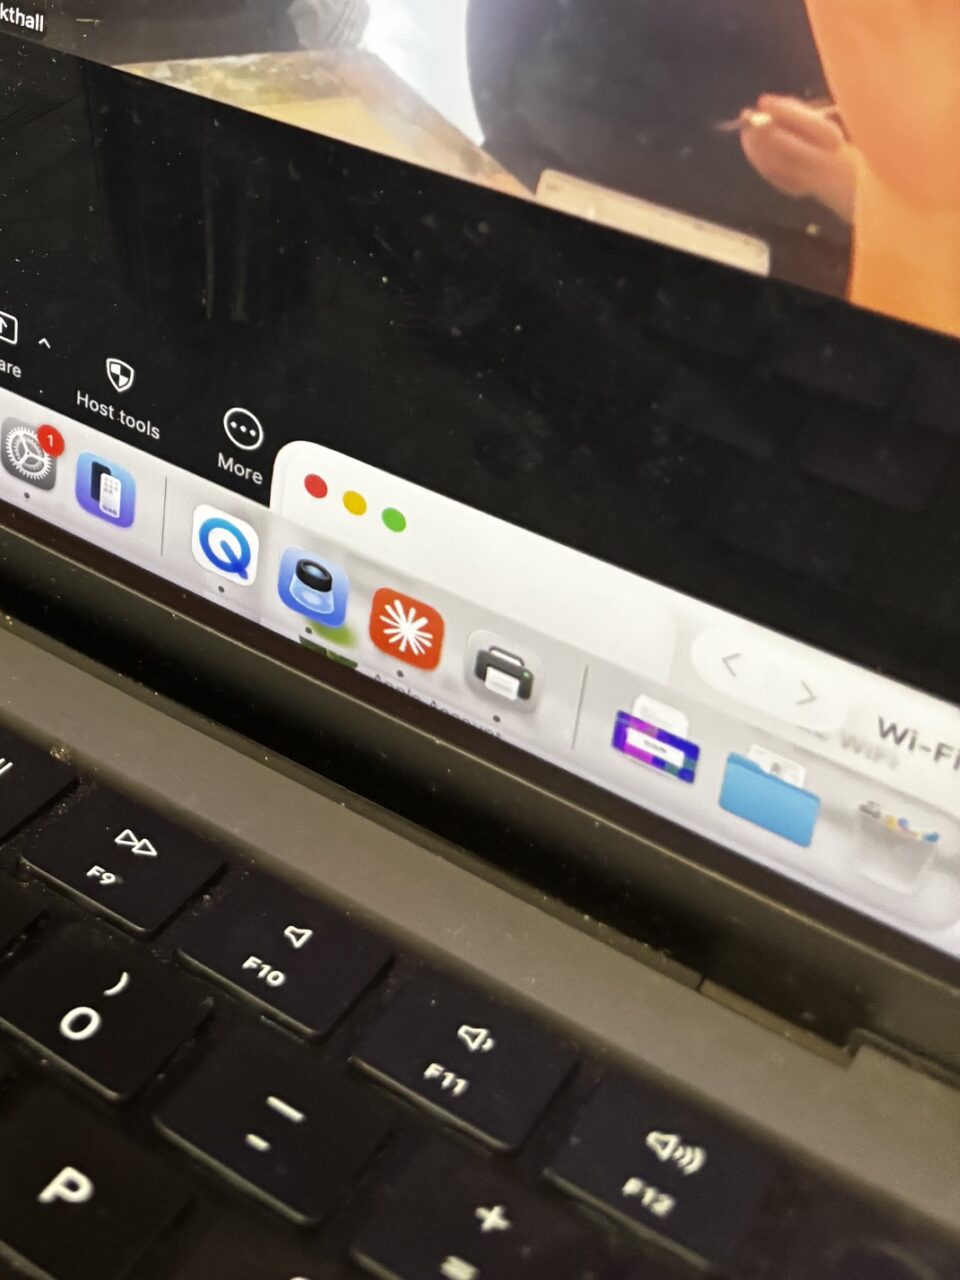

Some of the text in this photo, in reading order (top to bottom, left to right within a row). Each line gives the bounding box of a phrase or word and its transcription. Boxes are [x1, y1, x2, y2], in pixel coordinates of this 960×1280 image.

[76, 389, 161, 440] Host tools
[46, 434, 54, 447] 1
[217, 452, 264, 485] More
[86, 865, 117, 885] F9
[242, 955, 286, 987] F10
[423, 1063, 467, 1095] F11
[39, 1166, 93, 1203] P
[622, 1177, 674, 1215] F12
